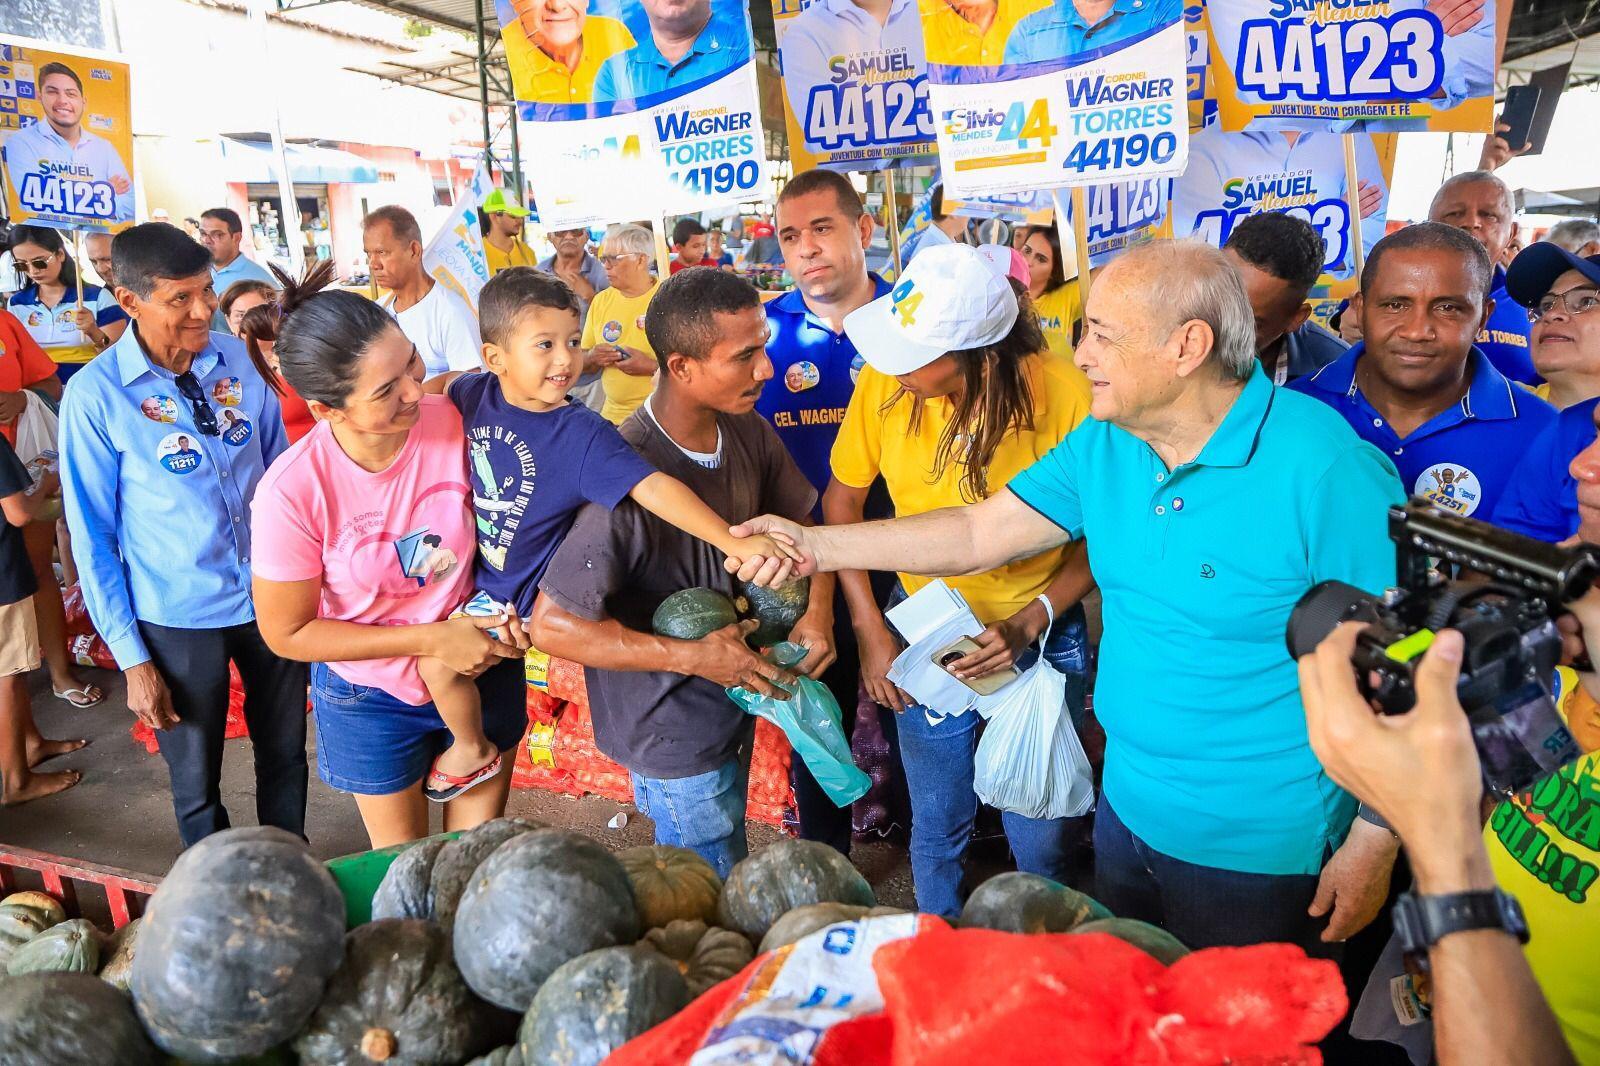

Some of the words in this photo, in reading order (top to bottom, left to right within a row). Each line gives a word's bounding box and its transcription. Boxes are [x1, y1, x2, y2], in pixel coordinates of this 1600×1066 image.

[1243, 17, 1436, 95] 44123
[829, 53, 915, 83] SAMUEL
[1105, 71, 1147, 84] CORONEL
[1066, 75, 1174, 108] WAGNER
[690, 106, 728, 118] CORONEL
[810, 79, 937, 145] 44123
[1071, 103, 1173, 136] TORRES
[1270, 104, 1317, 116] JUVENTUDE
[1319, 105, 1339, 116] COM
[1342, 104, 1388, 117] CORAGEM
[1391, 104, 1397, 115] E
[654, 111, 752, 142] WAGNER
[995, 98, 1058, 149] 44
[952, 130, 993, 142] MENDES
[661, 135, 753, 167] TORRES
[830, 151, 865, 161] JUVENTUDE
[866, 149, 881, 158] COM
[883, 145, 915, 156] CORAGEM
[917, 144, 921, 154] E
[1063, 132, 1176, 173] 44190
[38, 159, 94, 176] SAMUEL
[1248, 169, 1312, 182] VEREADOR
[23, 176, 114, 216] 44123
[1222, 177, 1318, 208] SAMUEL
[891, 279, 925, 328] 44
[1491, 330, 1527, 347] TORRES
[774, 411, 798, 427] CEL.
[800, 407, 849, 424] WAGNE
[230, 427, 250, 444] 11211
[472, 426, 491, 440] TIME
[494, 426, 503, 439] TO
[504, 431, 517, 445] BE
[169, 458, 196, 469] 11211
[353, 510, 384, 523] somos
